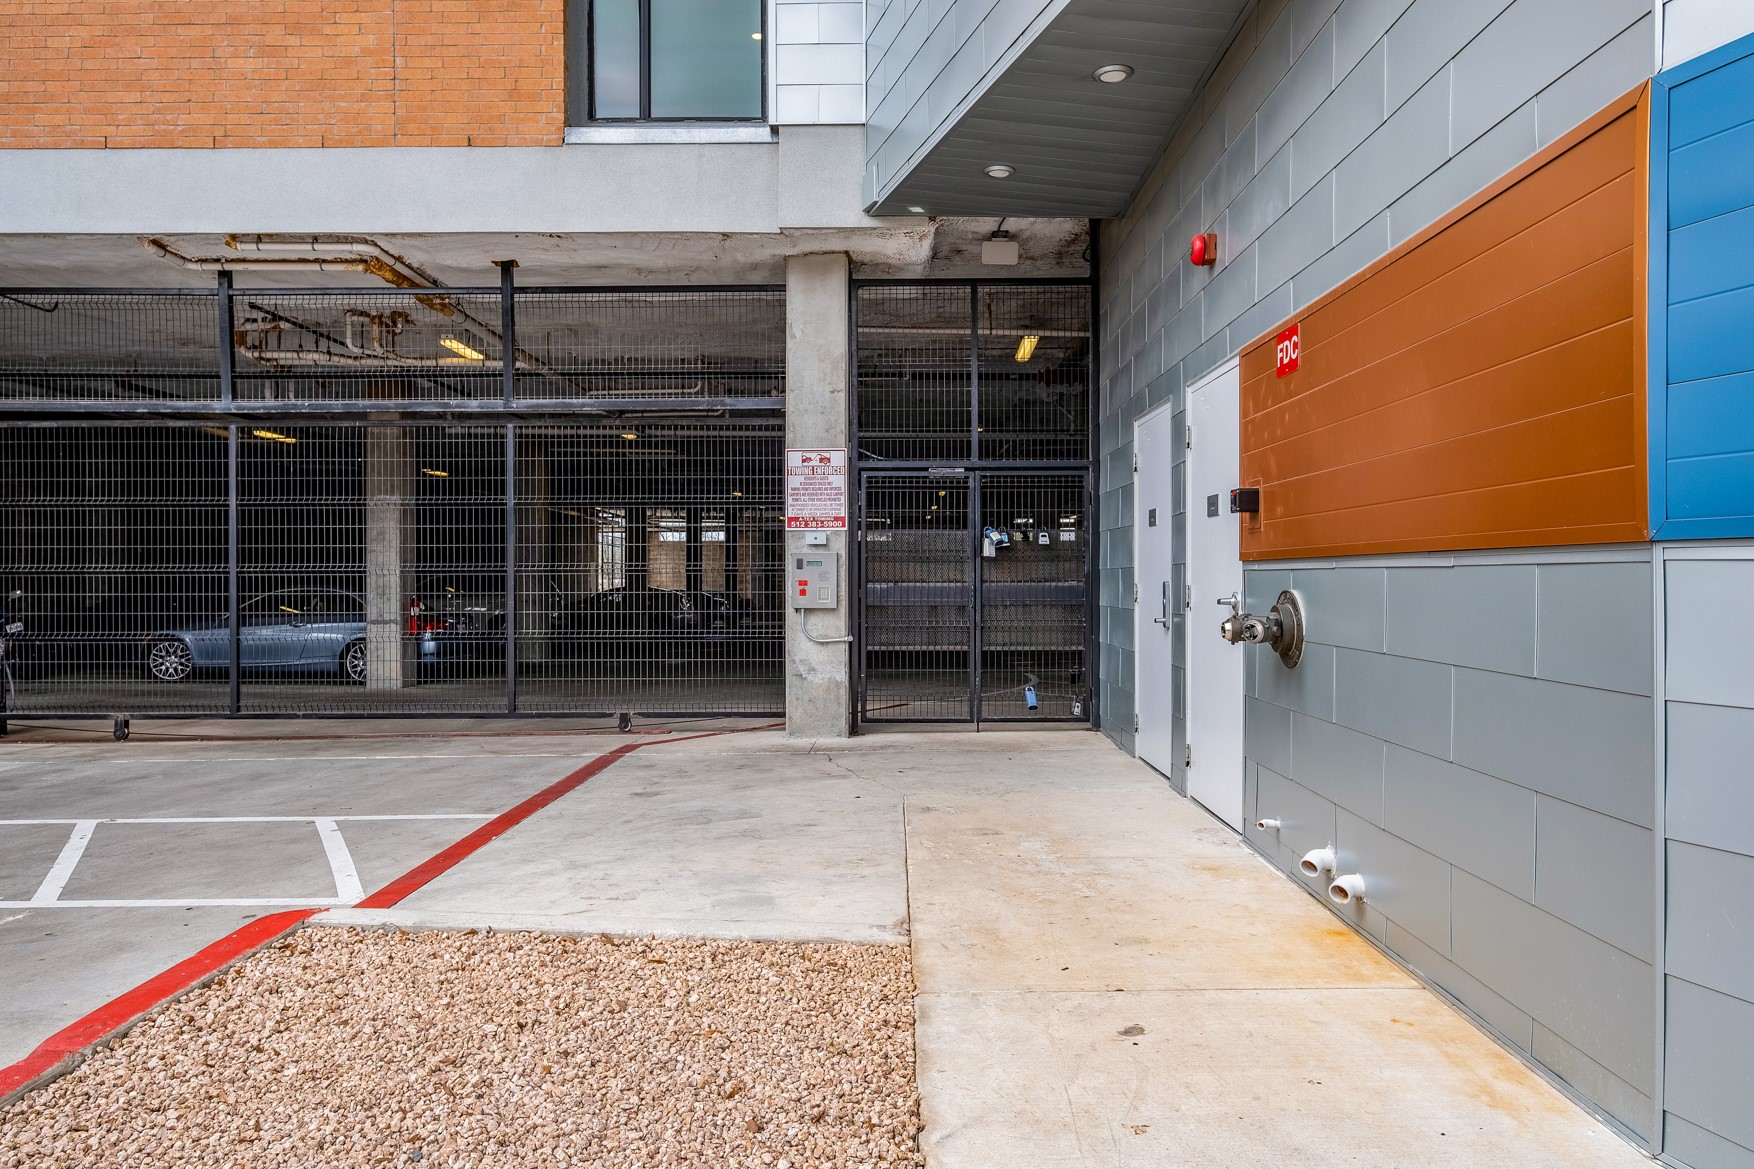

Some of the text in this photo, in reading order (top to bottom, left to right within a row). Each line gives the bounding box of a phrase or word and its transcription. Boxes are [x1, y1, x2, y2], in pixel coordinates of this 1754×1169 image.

[1277, 335, 1298, 367] FDC
[788, 466, 844, 475] TOWING ENFORCED
